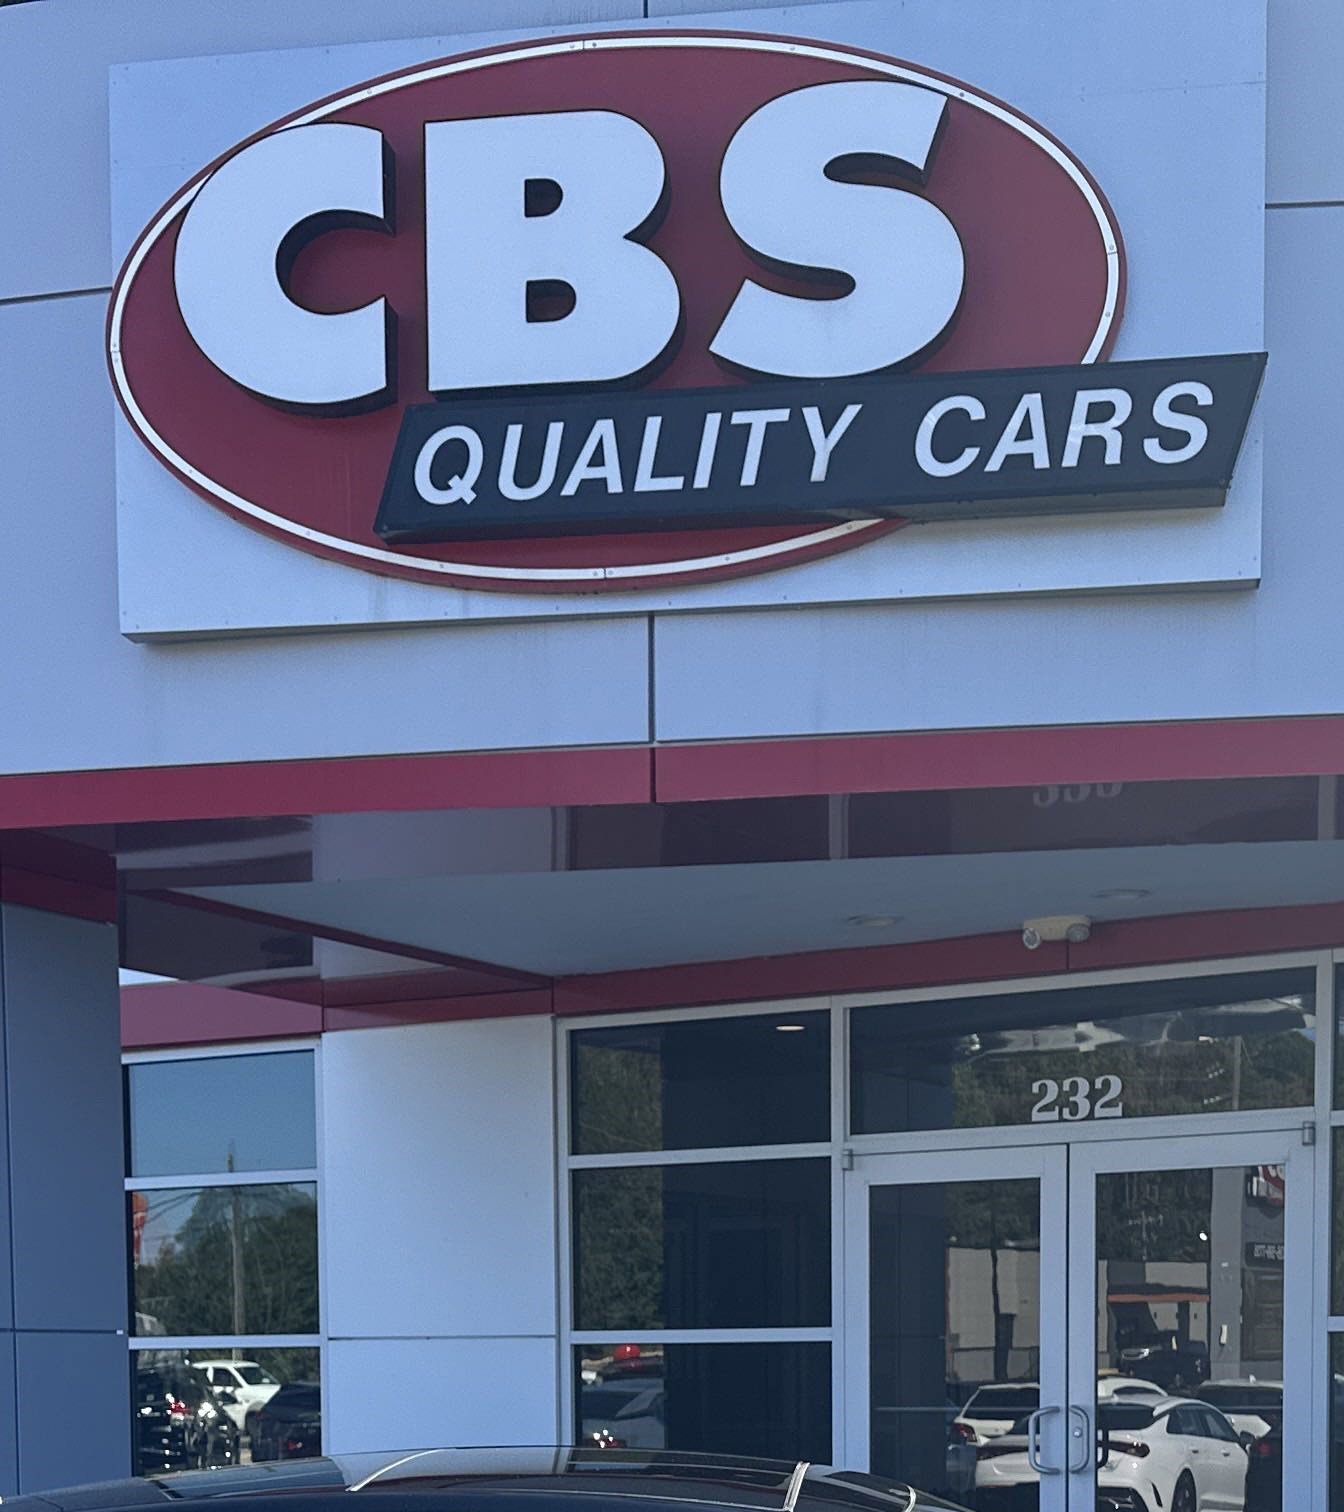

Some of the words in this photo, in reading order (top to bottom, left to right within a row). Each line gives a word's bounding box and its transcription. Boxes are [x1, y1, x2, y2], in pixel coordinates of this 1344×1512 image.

[173, 79, 966, 405] CBS
[413, 403, 863, 506] QUALITY
[914, 380, 1215, 478] CARS
[1031, 1074, 1123, 1122] 232
